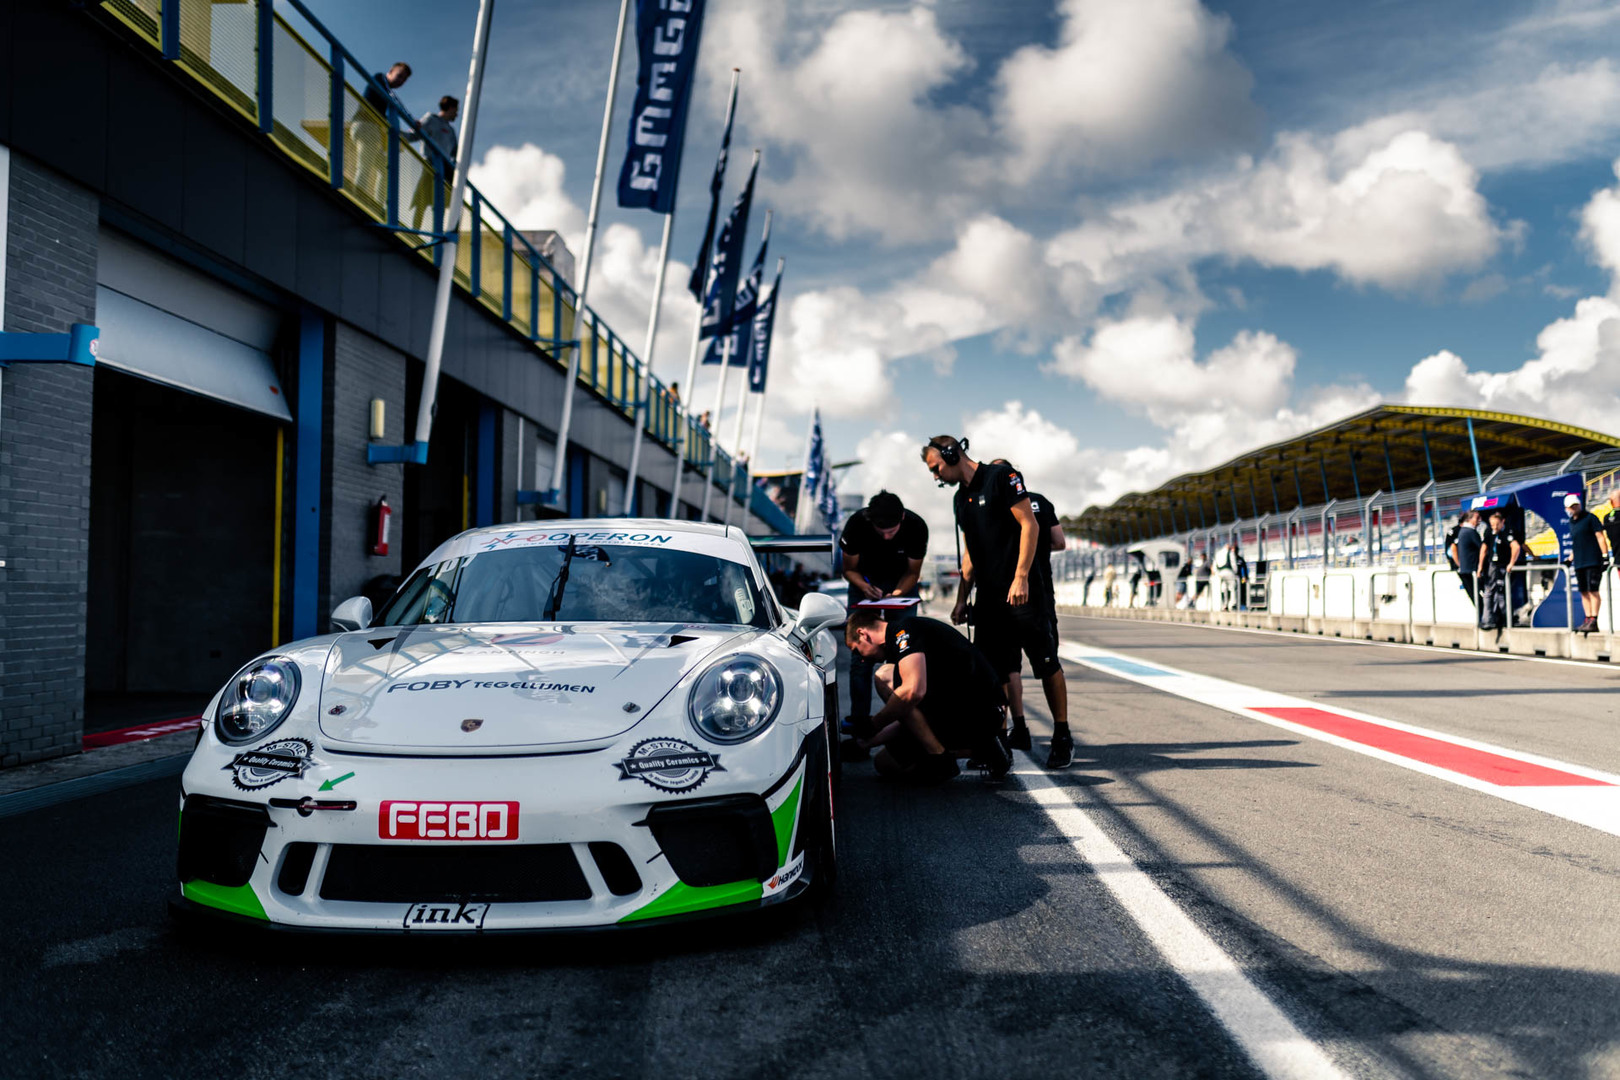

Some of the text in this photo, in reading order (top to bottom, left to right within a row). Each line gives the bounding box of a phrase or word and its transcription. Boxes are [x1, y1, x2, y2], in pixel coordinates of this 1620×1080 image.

[387, 680, 596, 693] FOBY TEGELLIJMEN
[266, 742, 306, 755] M-STYLE
[638, 742, 688, 755] M-STYLE
[248, 756, 296, 768] Quality Ceramics
[638, 756, 699, 769] Quality Ceramics
[389, 803, 508, 838] FEBO
